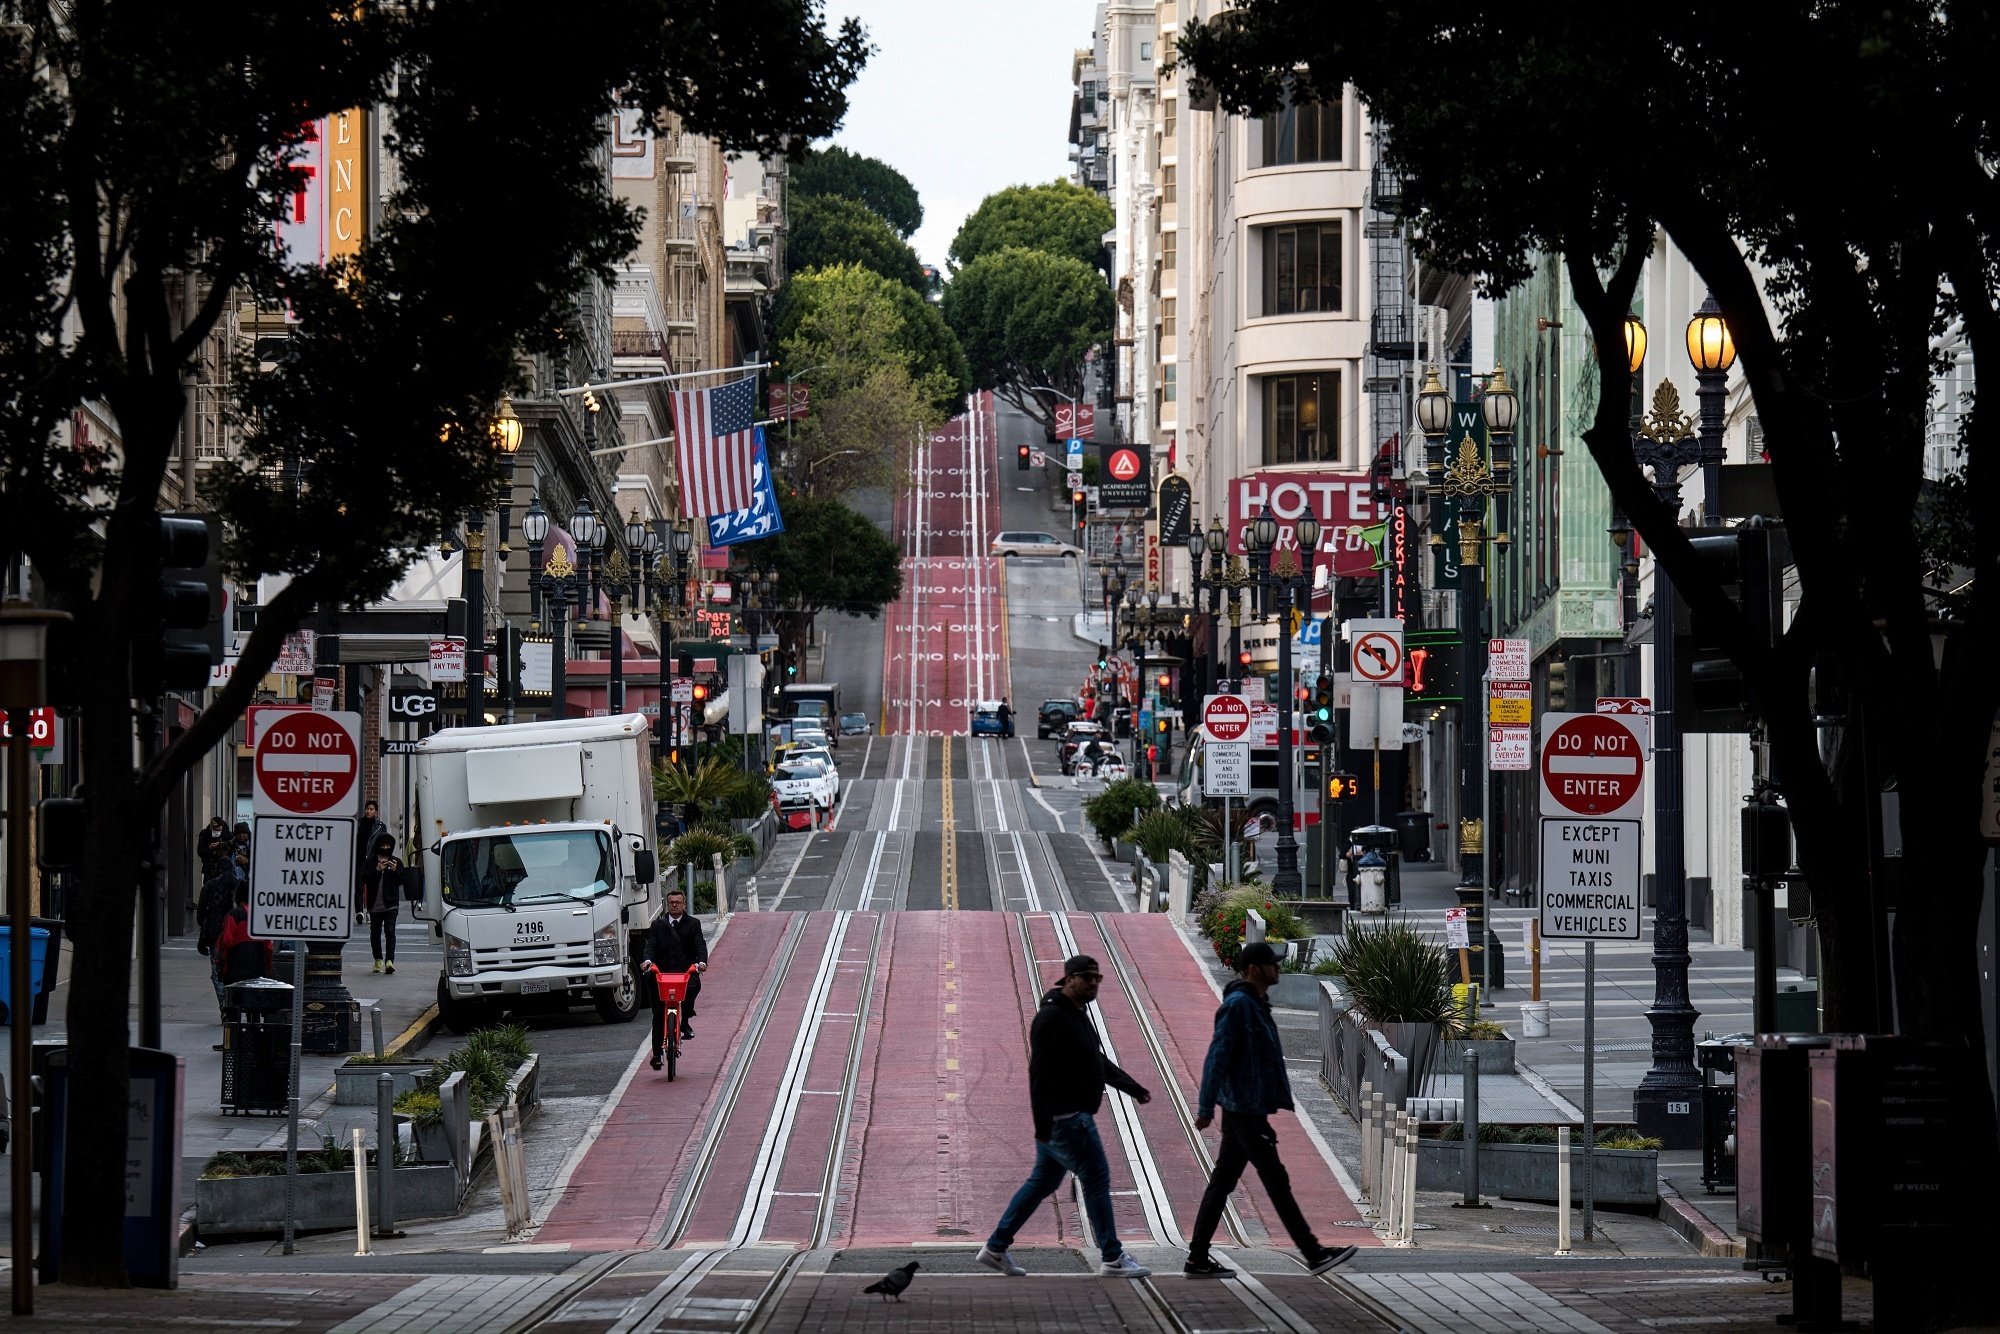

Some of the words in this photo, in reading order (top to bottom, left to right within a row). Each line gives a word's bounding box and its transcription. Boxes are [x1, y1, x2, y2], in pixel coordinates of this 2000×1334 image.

[1162, 491, 1190, 543] STARLIGHT
[1148, 535, 1159, 582] PARK
[696, 608, 731, 622] Sears
[1491, 641, 1503, 652] NO
[433, 662, 445, 670] ANY
[447, 662, 461, 670] TIME
[1491, 689, 1503, 698] NO
[1503, 691, 1529, 699] STOPPING
[391, 695, 436, 717] UGG
[1211, 704, 1222, 712] DO
[1227, 704, 1243, 712] NOT
[1214, 724, 1240, 732] ENTER
[271, 732, 296, 748] DO
[308, 733, 343, 748] NOT
[1491, 731, 1502, 741] NO
[1558, 735, 1582, 750] DO
[1594, 735, 1628, 750] NOT
[277, 778, 334, 794] ENTER
[786, 781, 810, 789] 339
[1349, 780, 1356, 795] 5
[1564, 780, 1620, 795] ENTER
[275, 825, 334, 840] EXCEPT
[1562, 826, 1620, 842] EXCEPT
[285, 847, 322, 863] MUNI
[1572, 849, 1610, 864] MUNI
[281, 869, 324, 886] TAXIS
[1569, 871, 1613, 887] TAXIS
[257, 891, 346, 909] COMMERCIAL
[1546, 893, 1635, 910] COMMERCIAL
[264, 914, 337, 931] VEHICLES
[516, 921, 544, 934] 2196
[1554, 916, 1627, 932] VEHICLES
[513, 934, 550, 944] ISUZU
[1669, 1104, 1688, 1112] 151
[1906, 1183, 1940, 1191] WEEKLY
